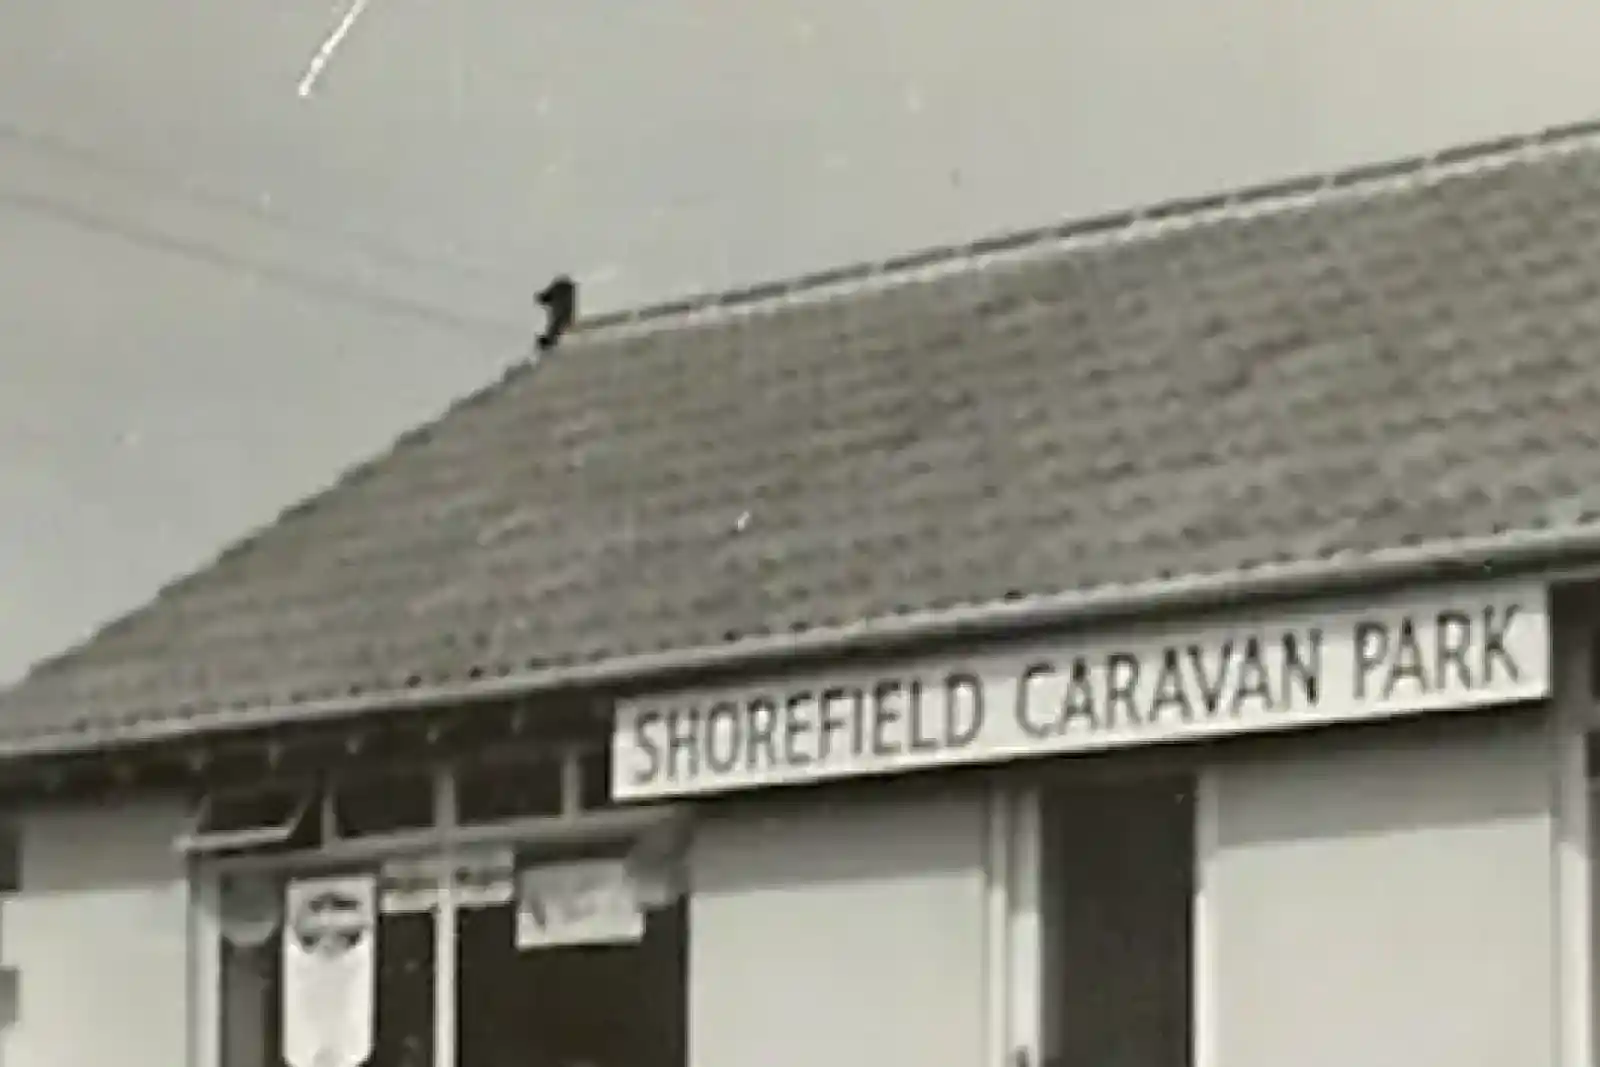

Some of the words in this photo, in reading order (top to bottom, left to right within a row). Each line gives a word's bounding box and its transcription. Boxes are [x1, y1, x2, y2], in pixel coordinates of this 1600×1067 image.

[632, 671, 985, 786] SHOREFIELD
[1014, 626, 1323, 737] CARAVAN
[1352, 604, 1521, 698] PARK
